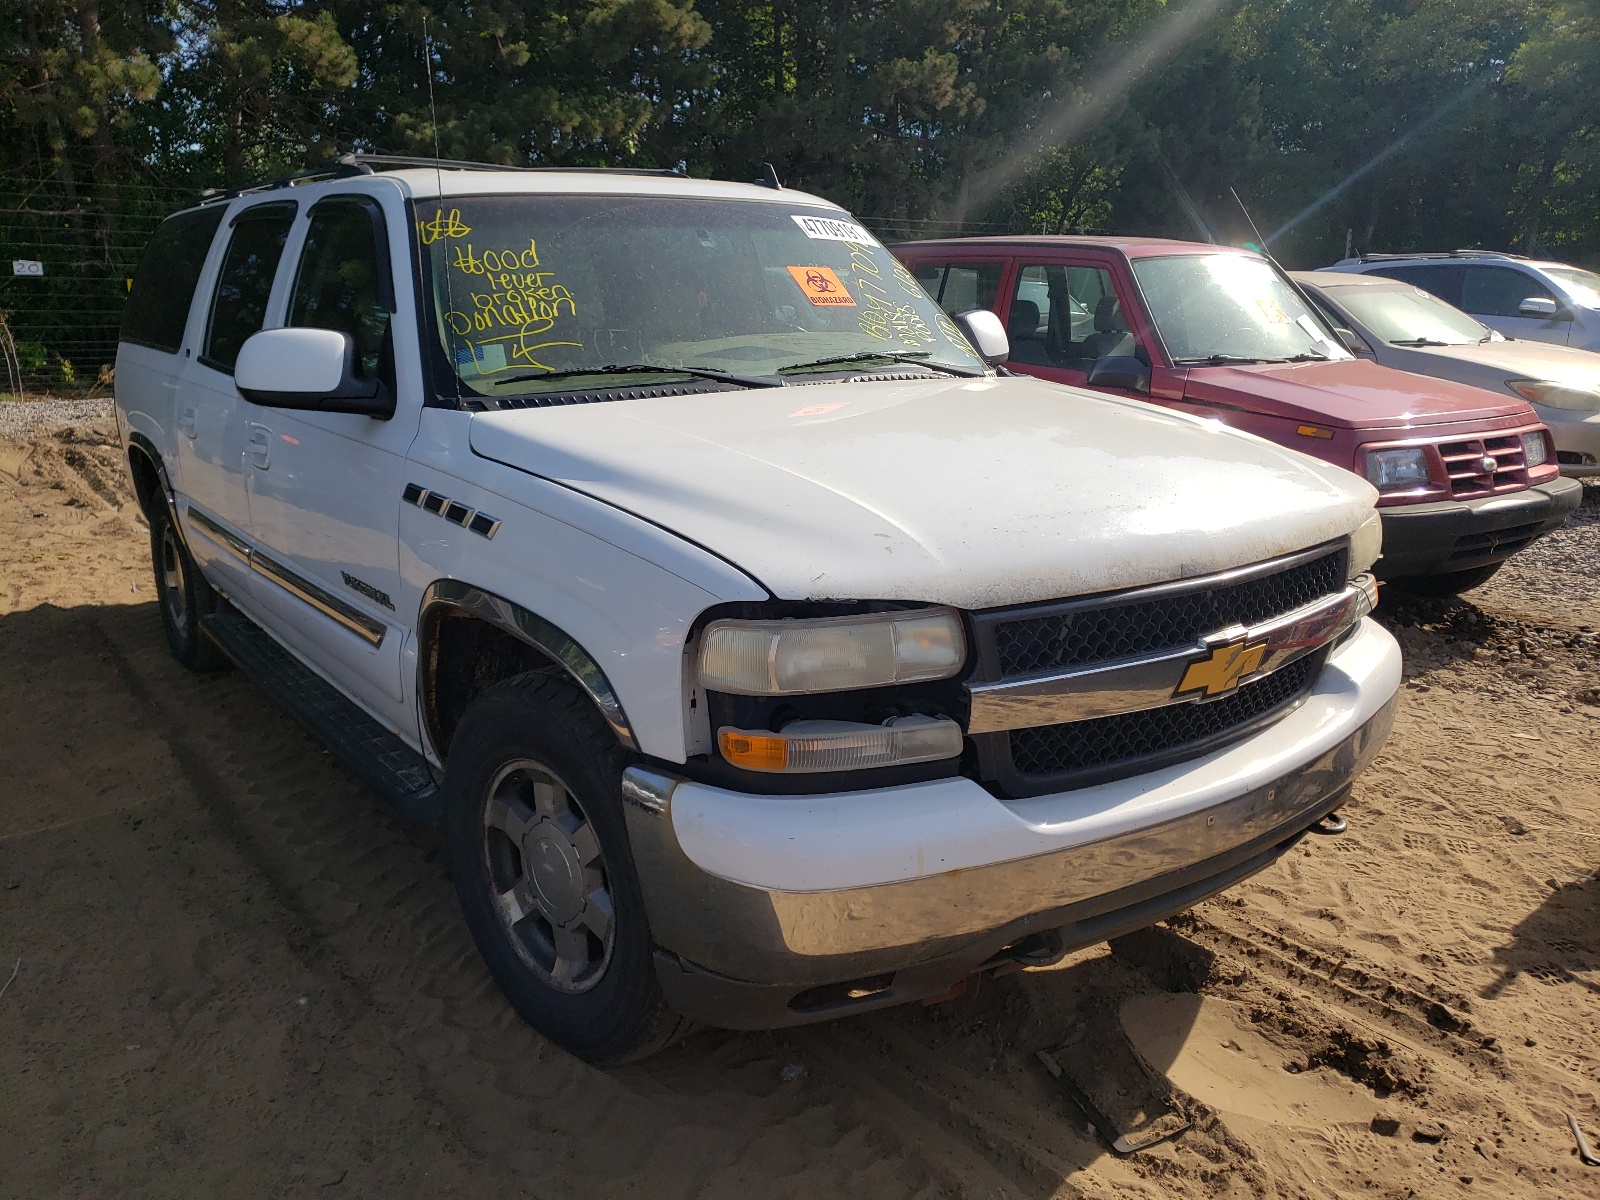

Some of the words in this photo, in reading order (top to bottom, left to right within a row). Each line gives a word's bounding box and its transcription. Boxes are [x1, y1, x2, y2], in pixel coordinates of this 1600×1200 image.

[16, 263, 39, 273] 20
[470, 285, 572, 309] broken
[809, 296, 854, 304] BIOHAZARD
